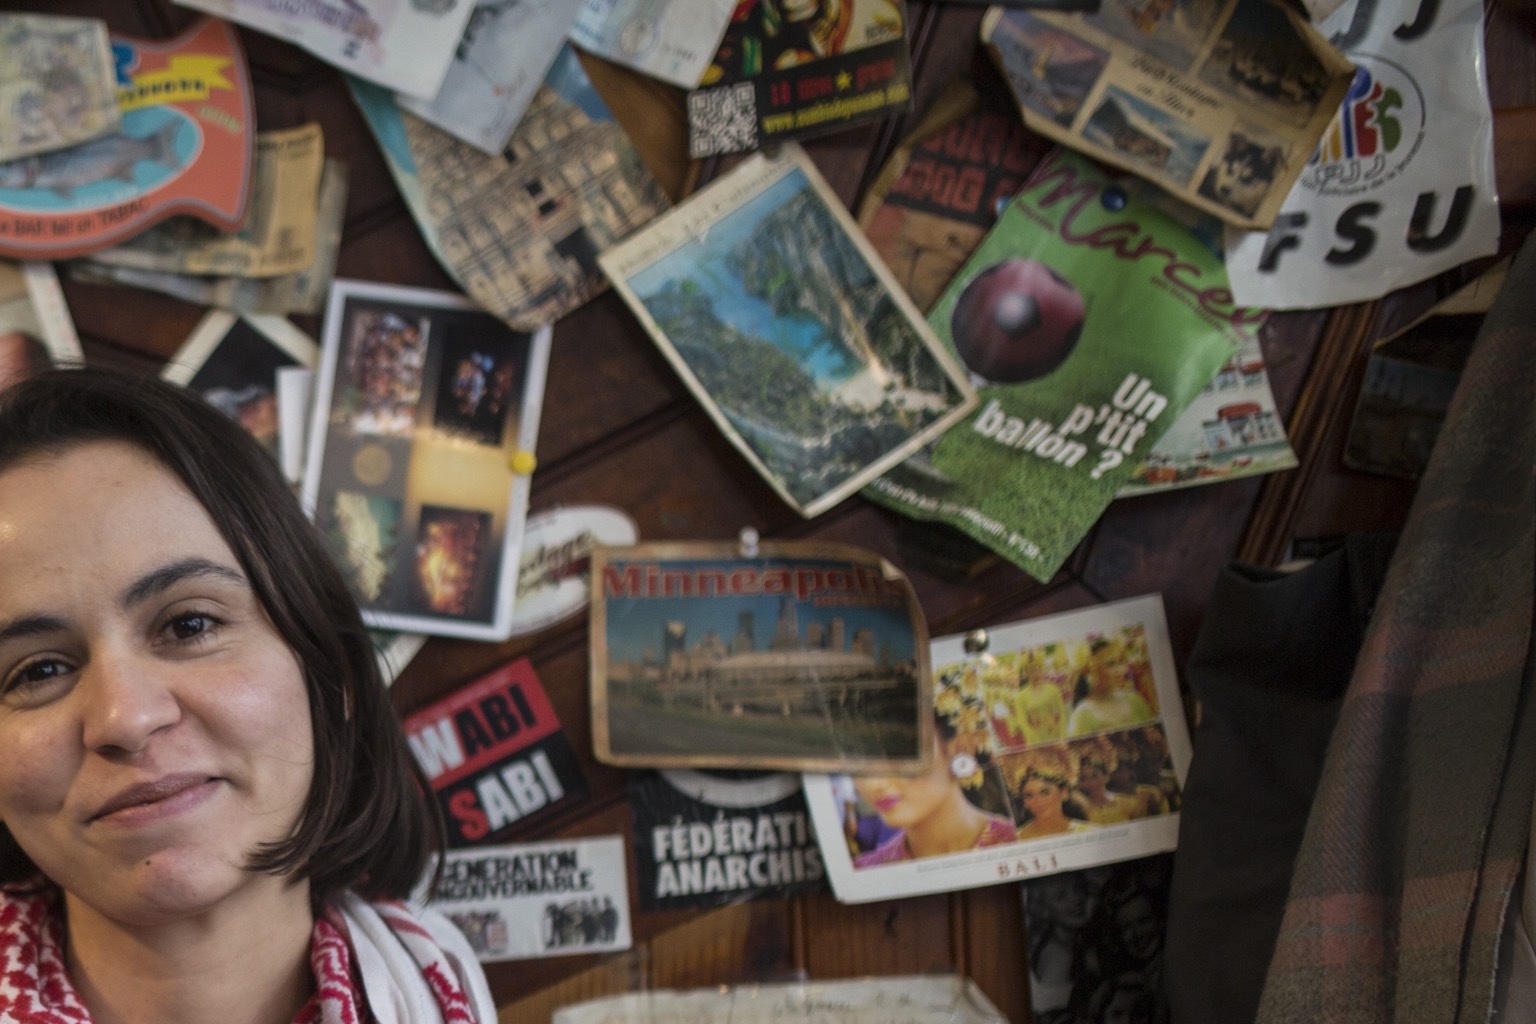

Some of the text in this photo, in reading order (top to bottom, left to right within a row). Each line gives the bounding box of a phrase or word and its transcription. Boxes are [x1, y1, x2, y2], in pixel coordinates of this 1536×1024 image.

[1257, 184, 1476, 273] FSU
[973, 399, 1088, 468] ballon
[1113, 371, 1168, 422] Un
[408, 682, 538, 780] WABI
[449, 749, 564, 841] SABI
[996, 853, 1059, 878] BALI
